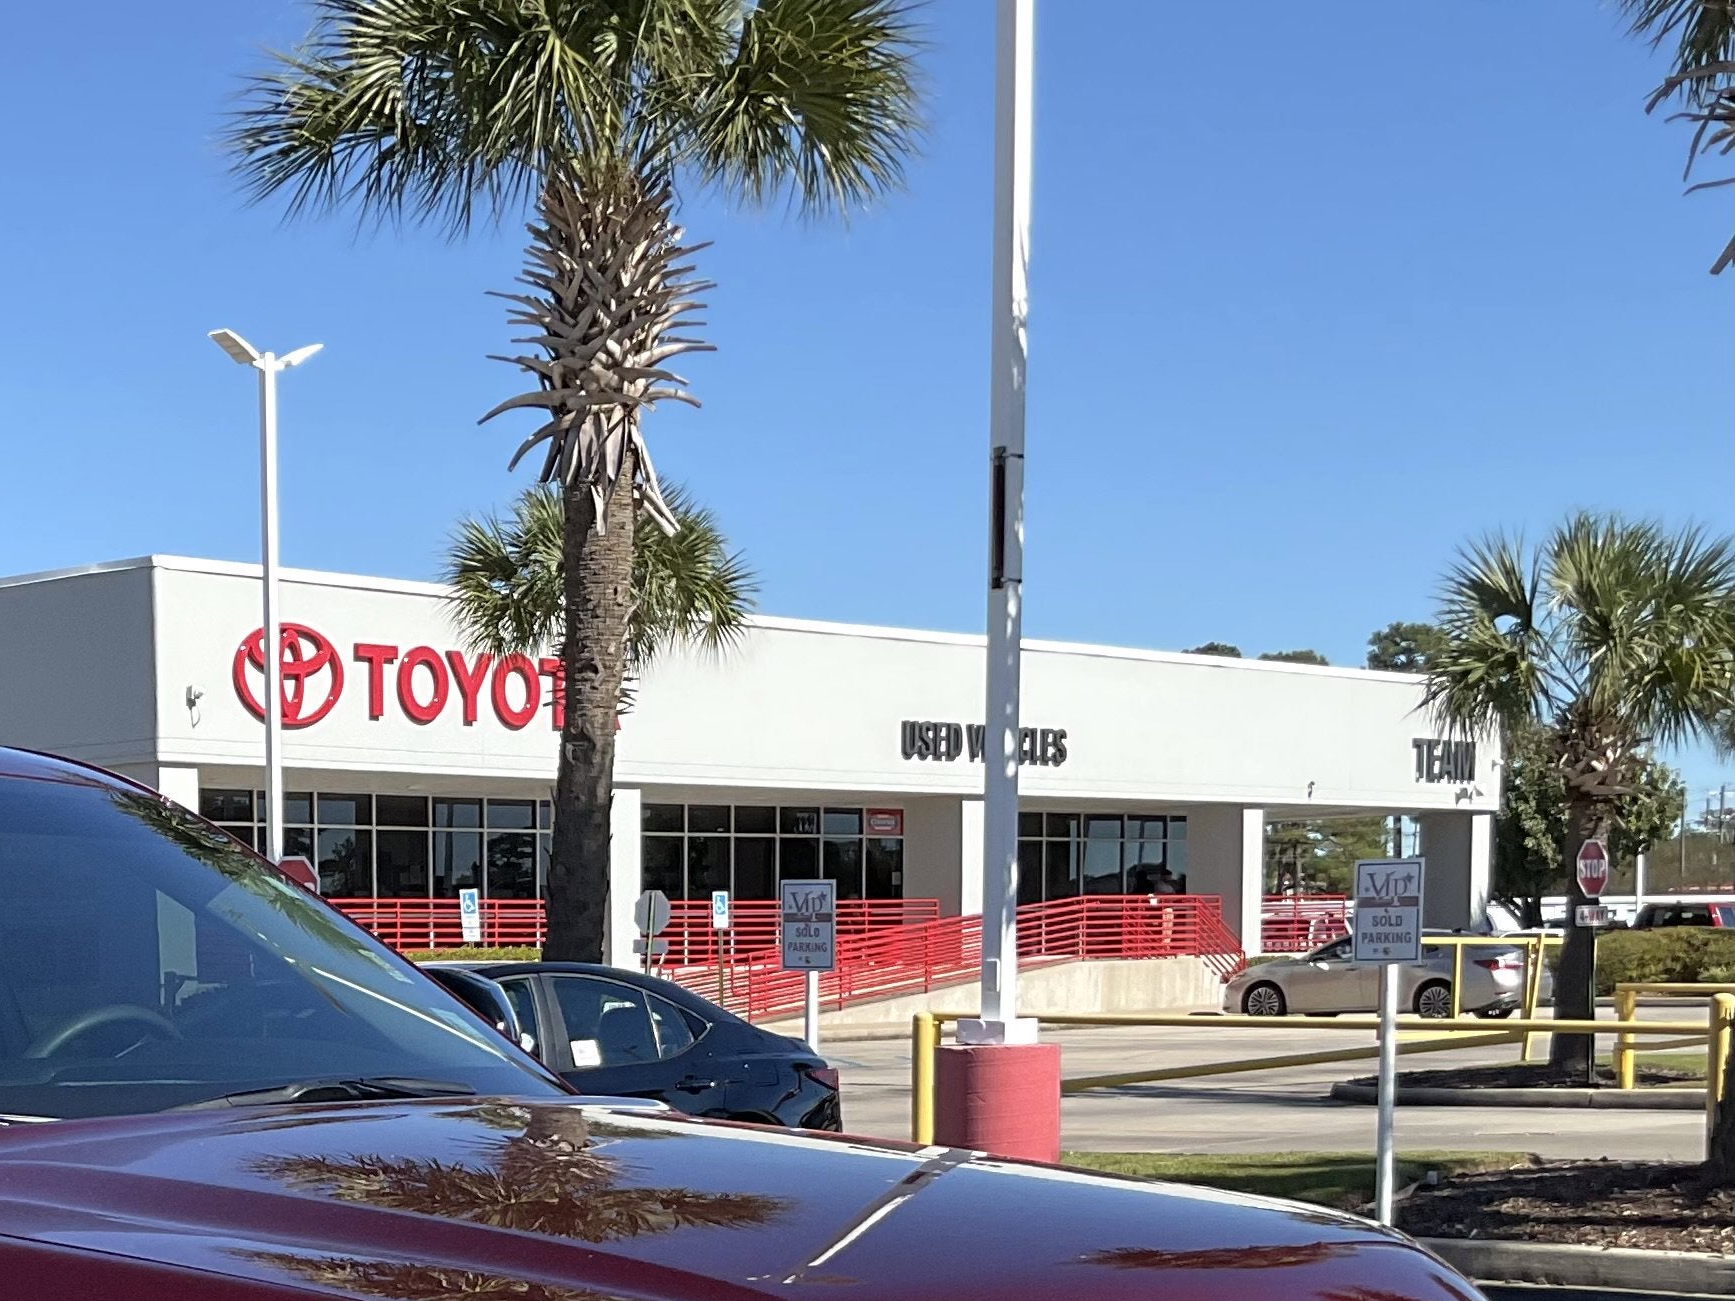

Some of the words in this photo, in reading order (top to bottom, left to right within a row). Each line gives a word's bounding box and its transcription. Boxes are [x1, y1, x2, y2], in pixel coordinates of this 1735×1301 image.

[353, 643, 621, 731] TOYOT
[901, 720, 963, 762] USED
[966, 724, 1068, 767] VCLES
[1412, 738, 1476, 784] TEAM
[1579, 859, 1606, 878] STOP
[1371, 915, 1403, 927] SOLD
[1579, 909, 1605, 921] 4-WAY
[795, 927, 820, 938] SOLD
[1361, 932, 1412, 944] PARKING
[787, 942, 828, 953] PARKING
